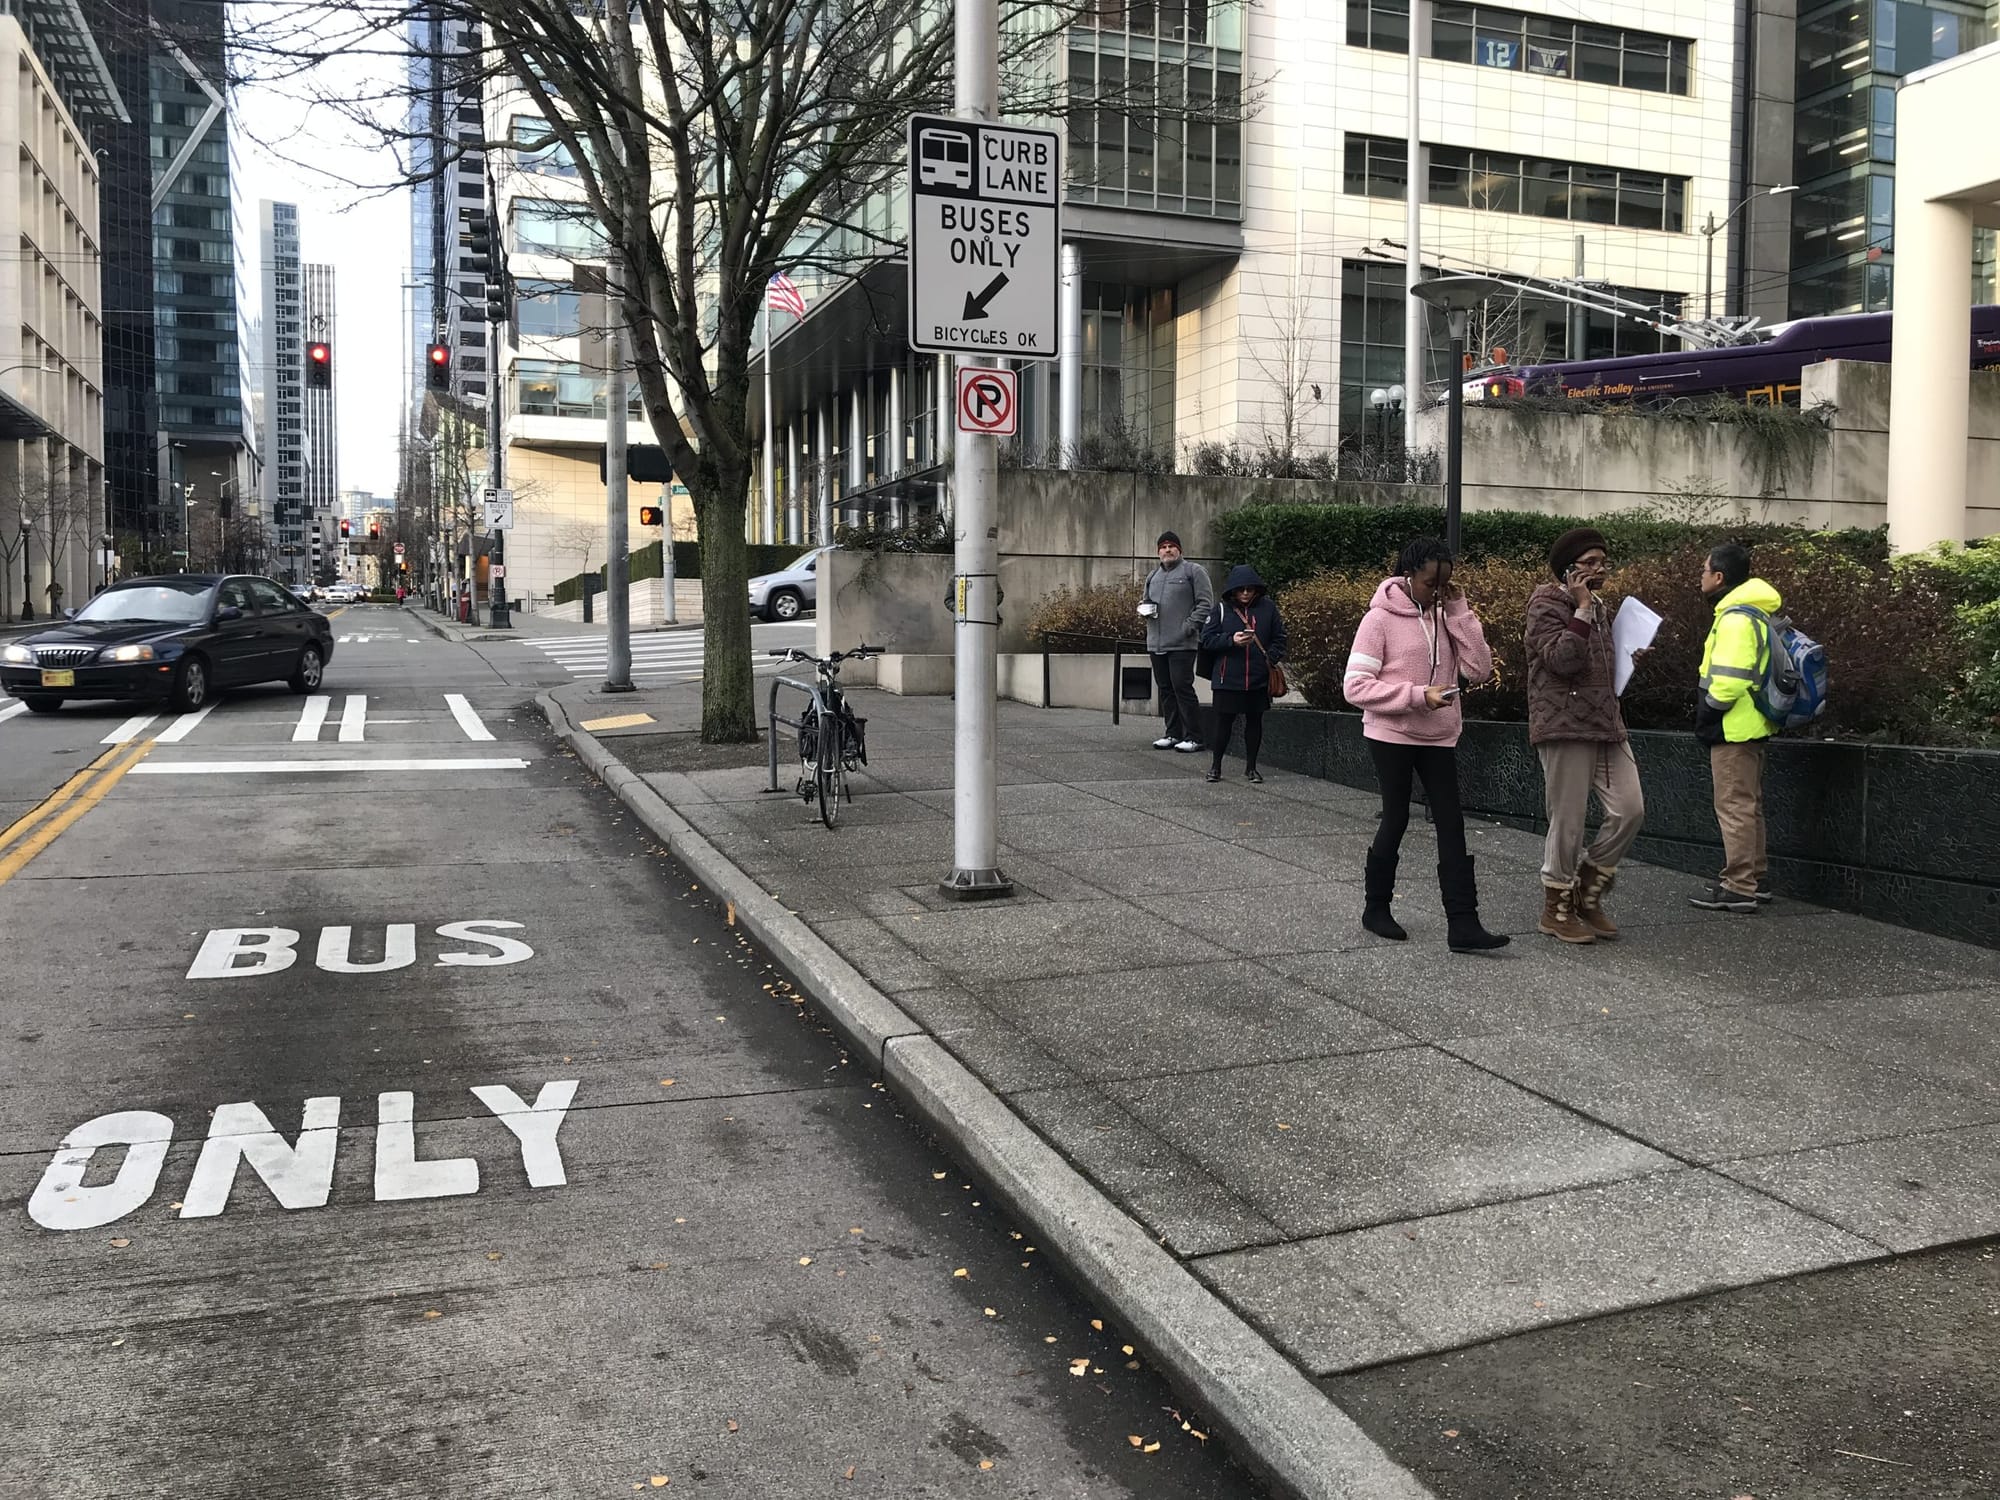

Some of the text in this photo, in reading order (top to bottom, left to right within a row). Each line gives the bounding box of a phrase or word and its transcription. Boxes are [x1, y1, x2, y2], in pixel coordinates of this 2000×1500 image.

[1486, 41, 1511, 68] 12
[1541, 53, 1558, 68] W
[985, 137, 1048, 166] CURB
[986, 166, 1048, 194] LANE
[941, 203, 1030, 237] BUSES
[950, 238, 1021, 268] ONLY
[934, 326, 1037, 347] BICYCLES OK
[1567, 386, 1601, 398] Electric
[1603, 383, 1634, 395] Trolley
[185, 920, 535, 980] BUS
[27, 1080, 580, 1231] ONLY
